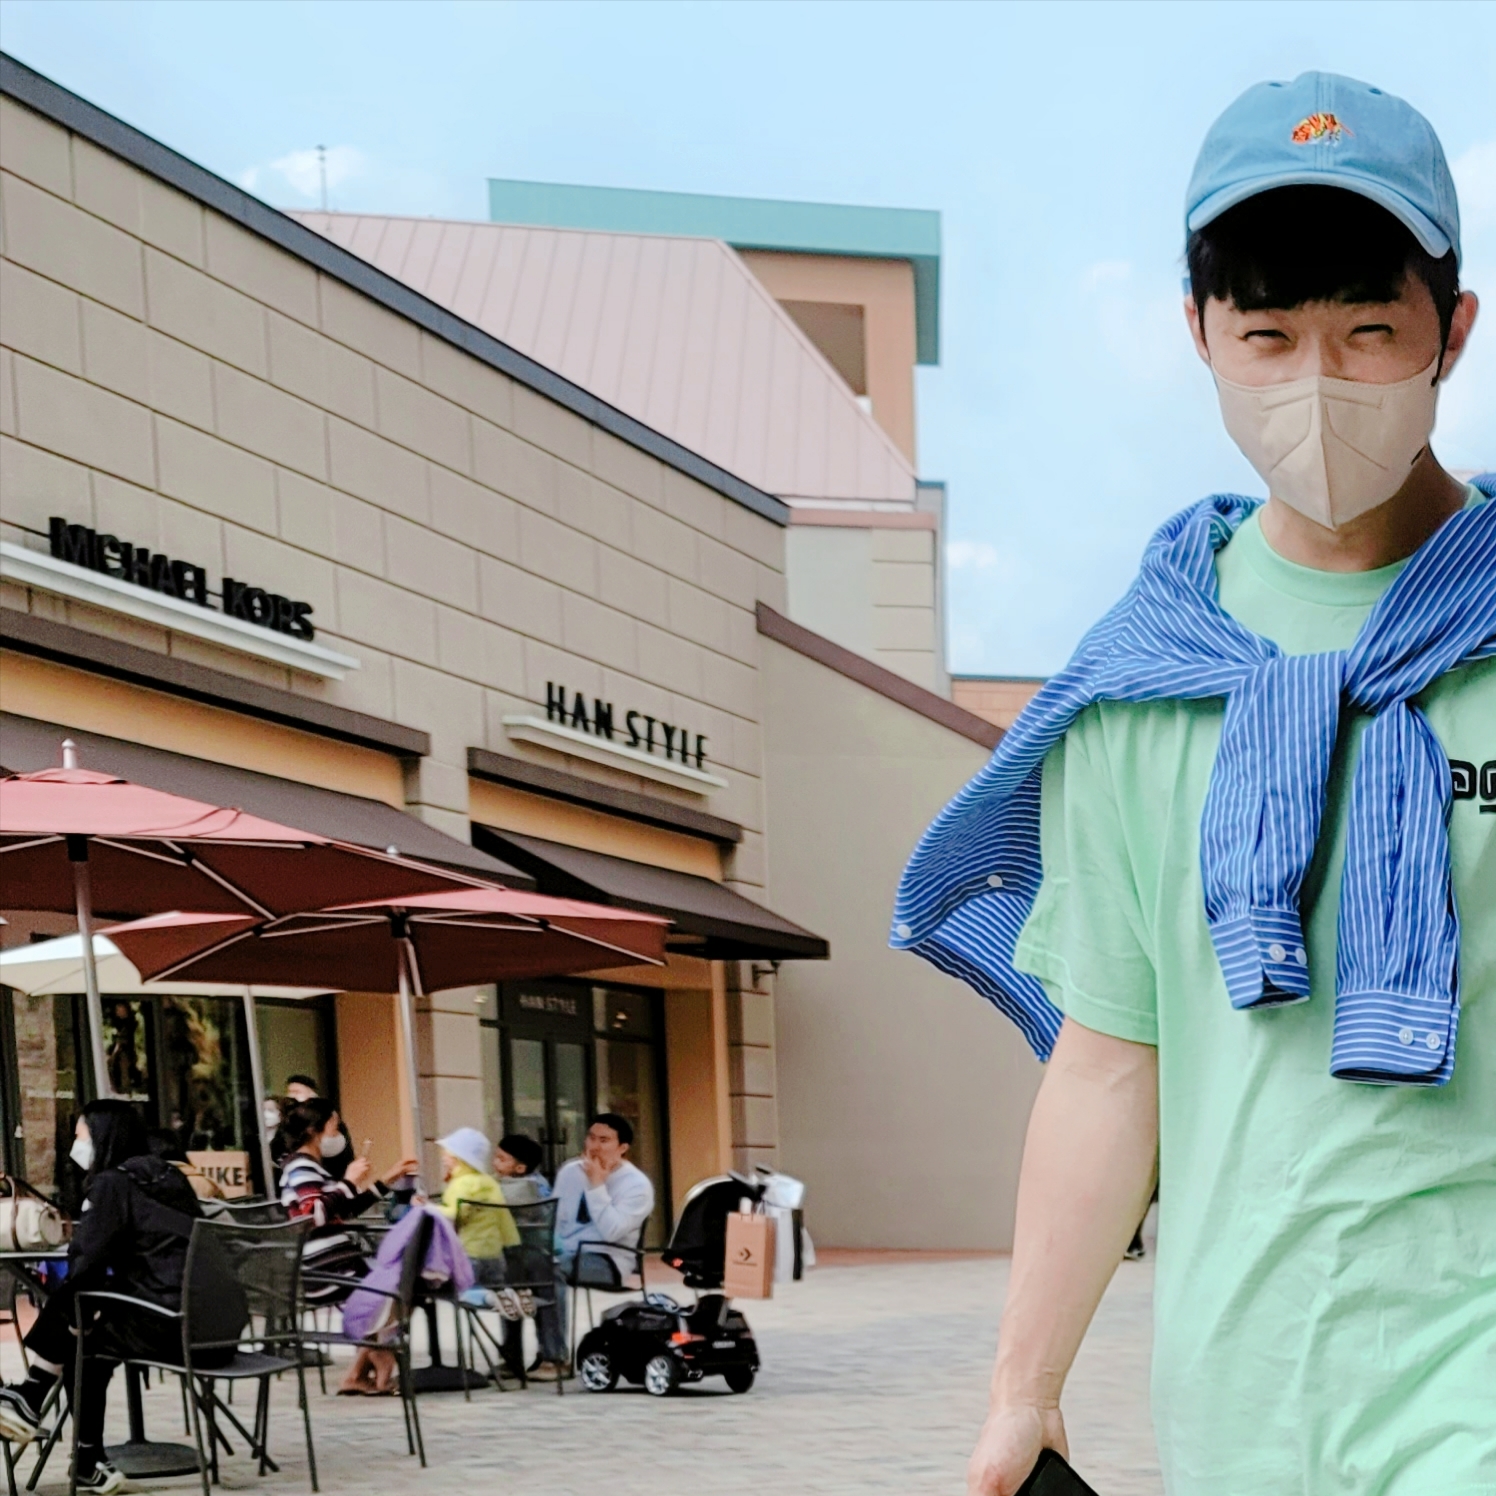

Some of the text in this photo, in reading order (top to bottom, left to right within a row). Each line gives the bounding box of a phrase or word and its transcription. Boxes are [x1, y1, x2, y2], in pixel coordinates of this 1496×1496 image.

[49, 516, 315, 642] MICHAEL KORS
[547, 681, 708, 769] HAN STYLE
